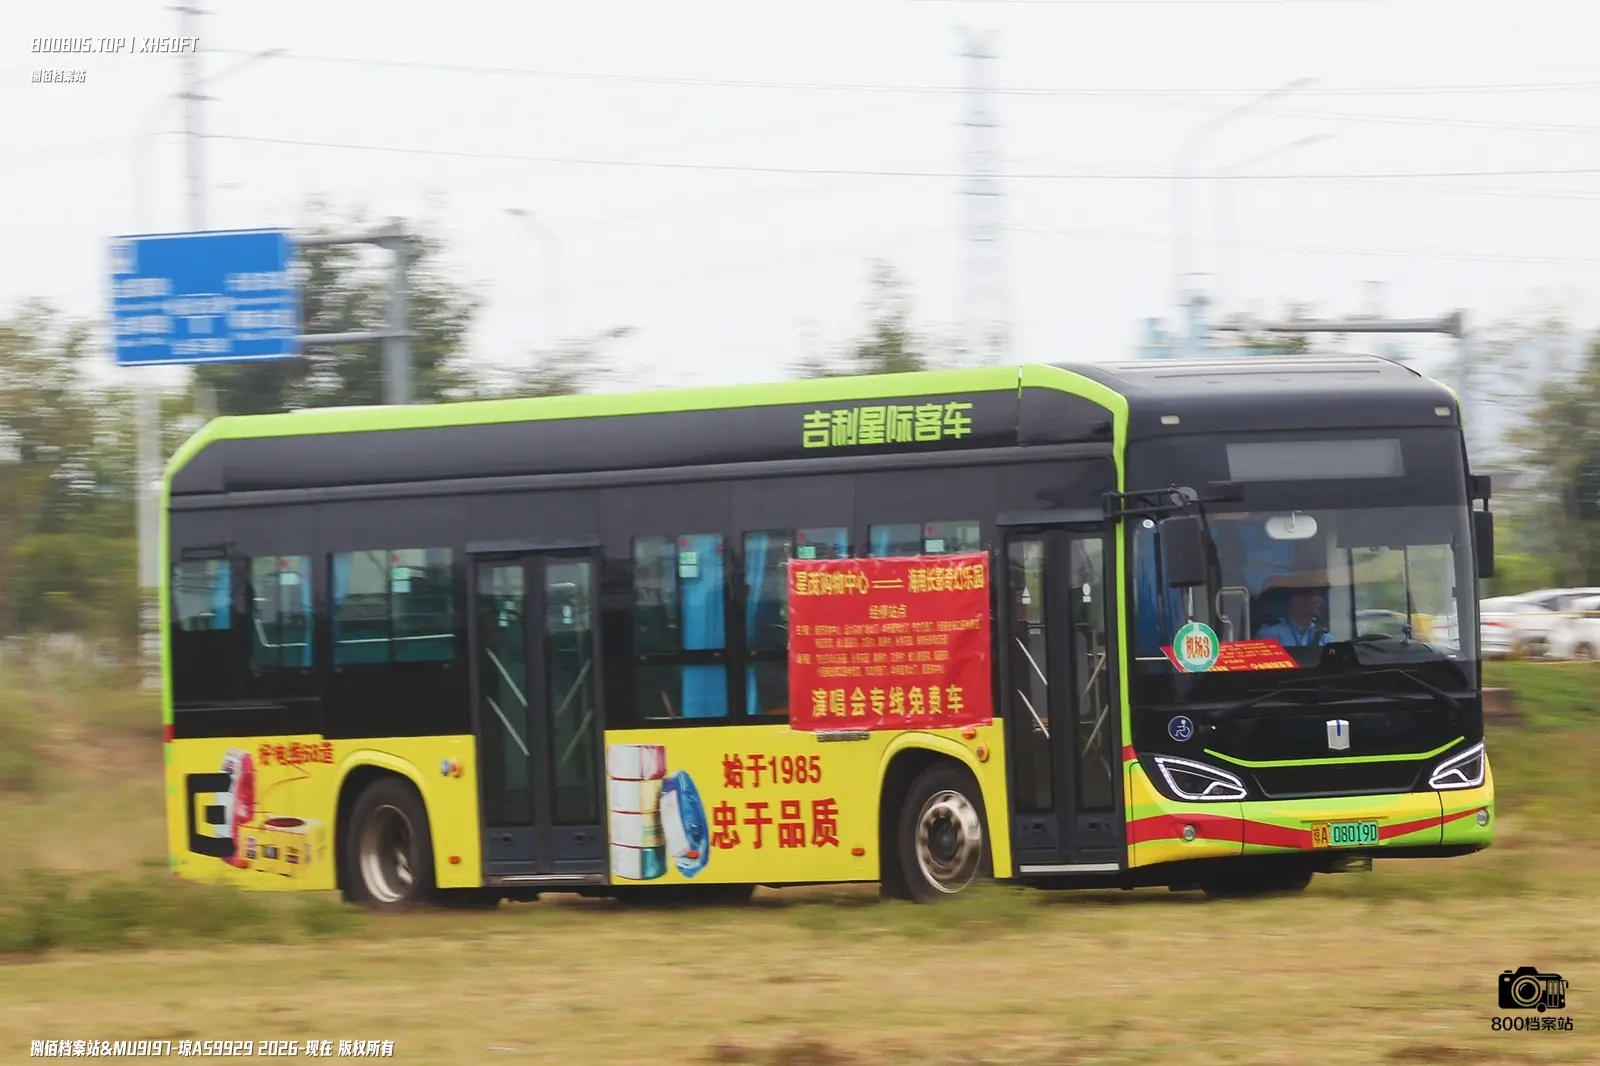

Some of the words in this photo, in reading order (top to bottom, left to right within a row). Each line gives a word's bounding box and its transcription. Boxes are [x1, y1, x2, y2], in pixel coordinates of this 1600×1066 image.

[802, 401, 974, 448] 吉利星际客车
[811, 684, 965, 717] 演唱会专线免费车
[721, 753, 822, 789] 始于1985
[710, 797, 840, 849] 忠于品质
